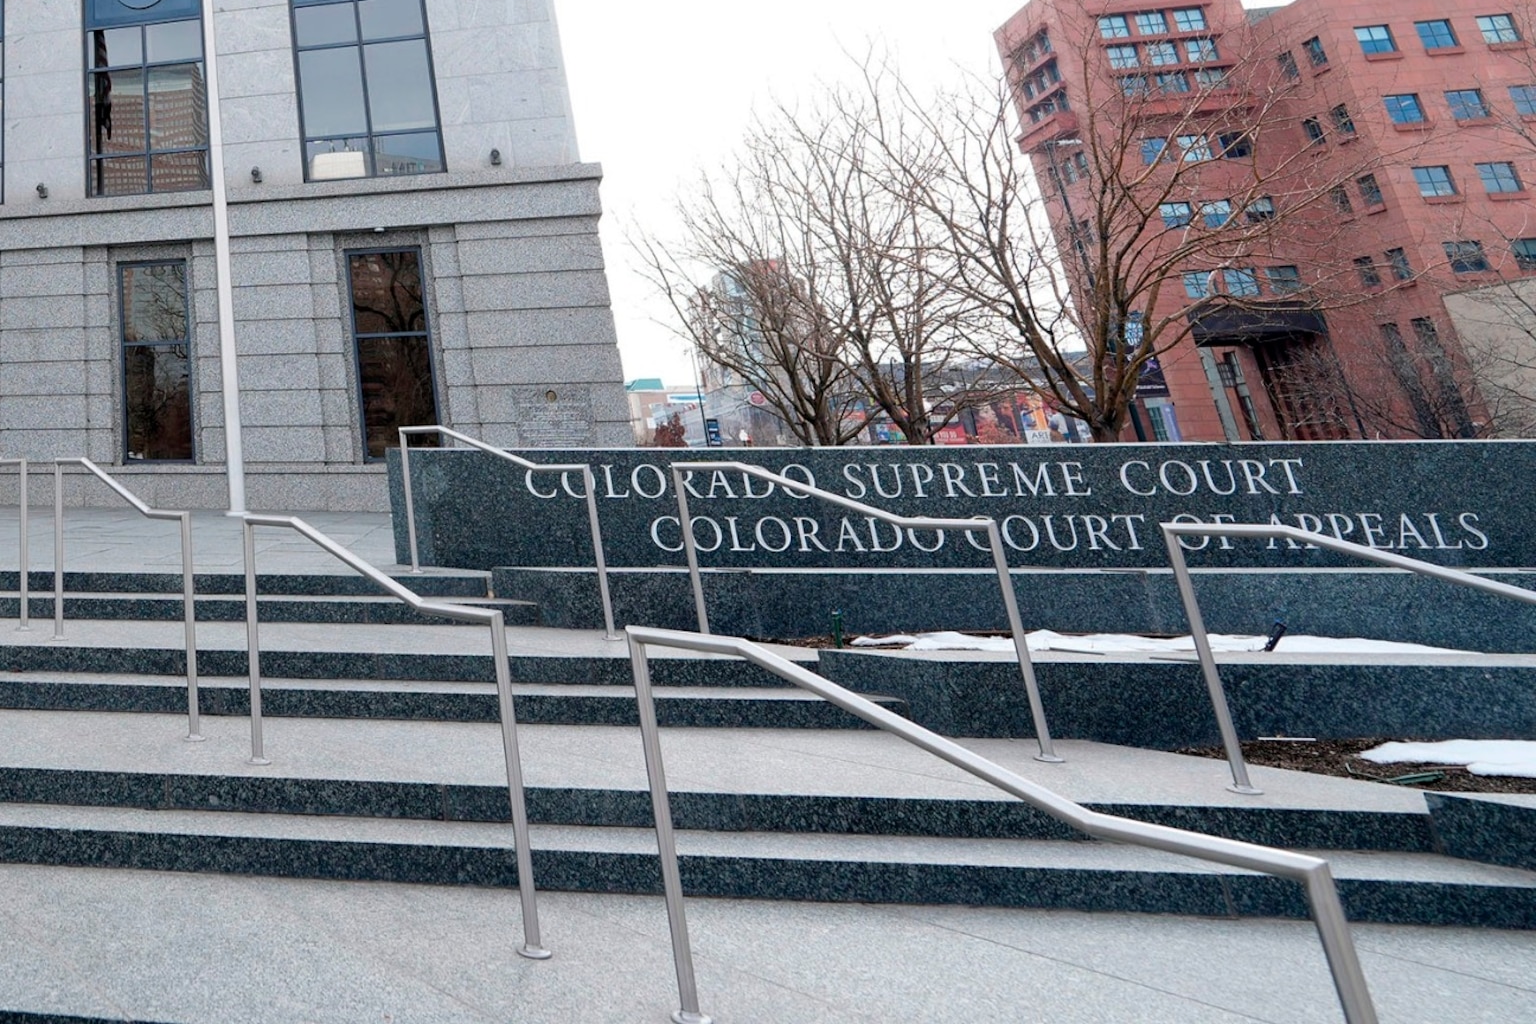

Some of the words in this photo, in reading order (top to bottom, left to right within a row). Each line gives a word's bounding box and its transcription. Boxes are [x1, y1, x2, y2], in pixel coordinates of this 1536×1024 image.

[843, 461, 1092, 499] SUPREME
[1119, 457, 1305, 497] COURT
[650, 515, 945, 553] COLORADO
[1170, 513, 1236, 551] OF
[1265, 511, 1489, 551] APPEALS
